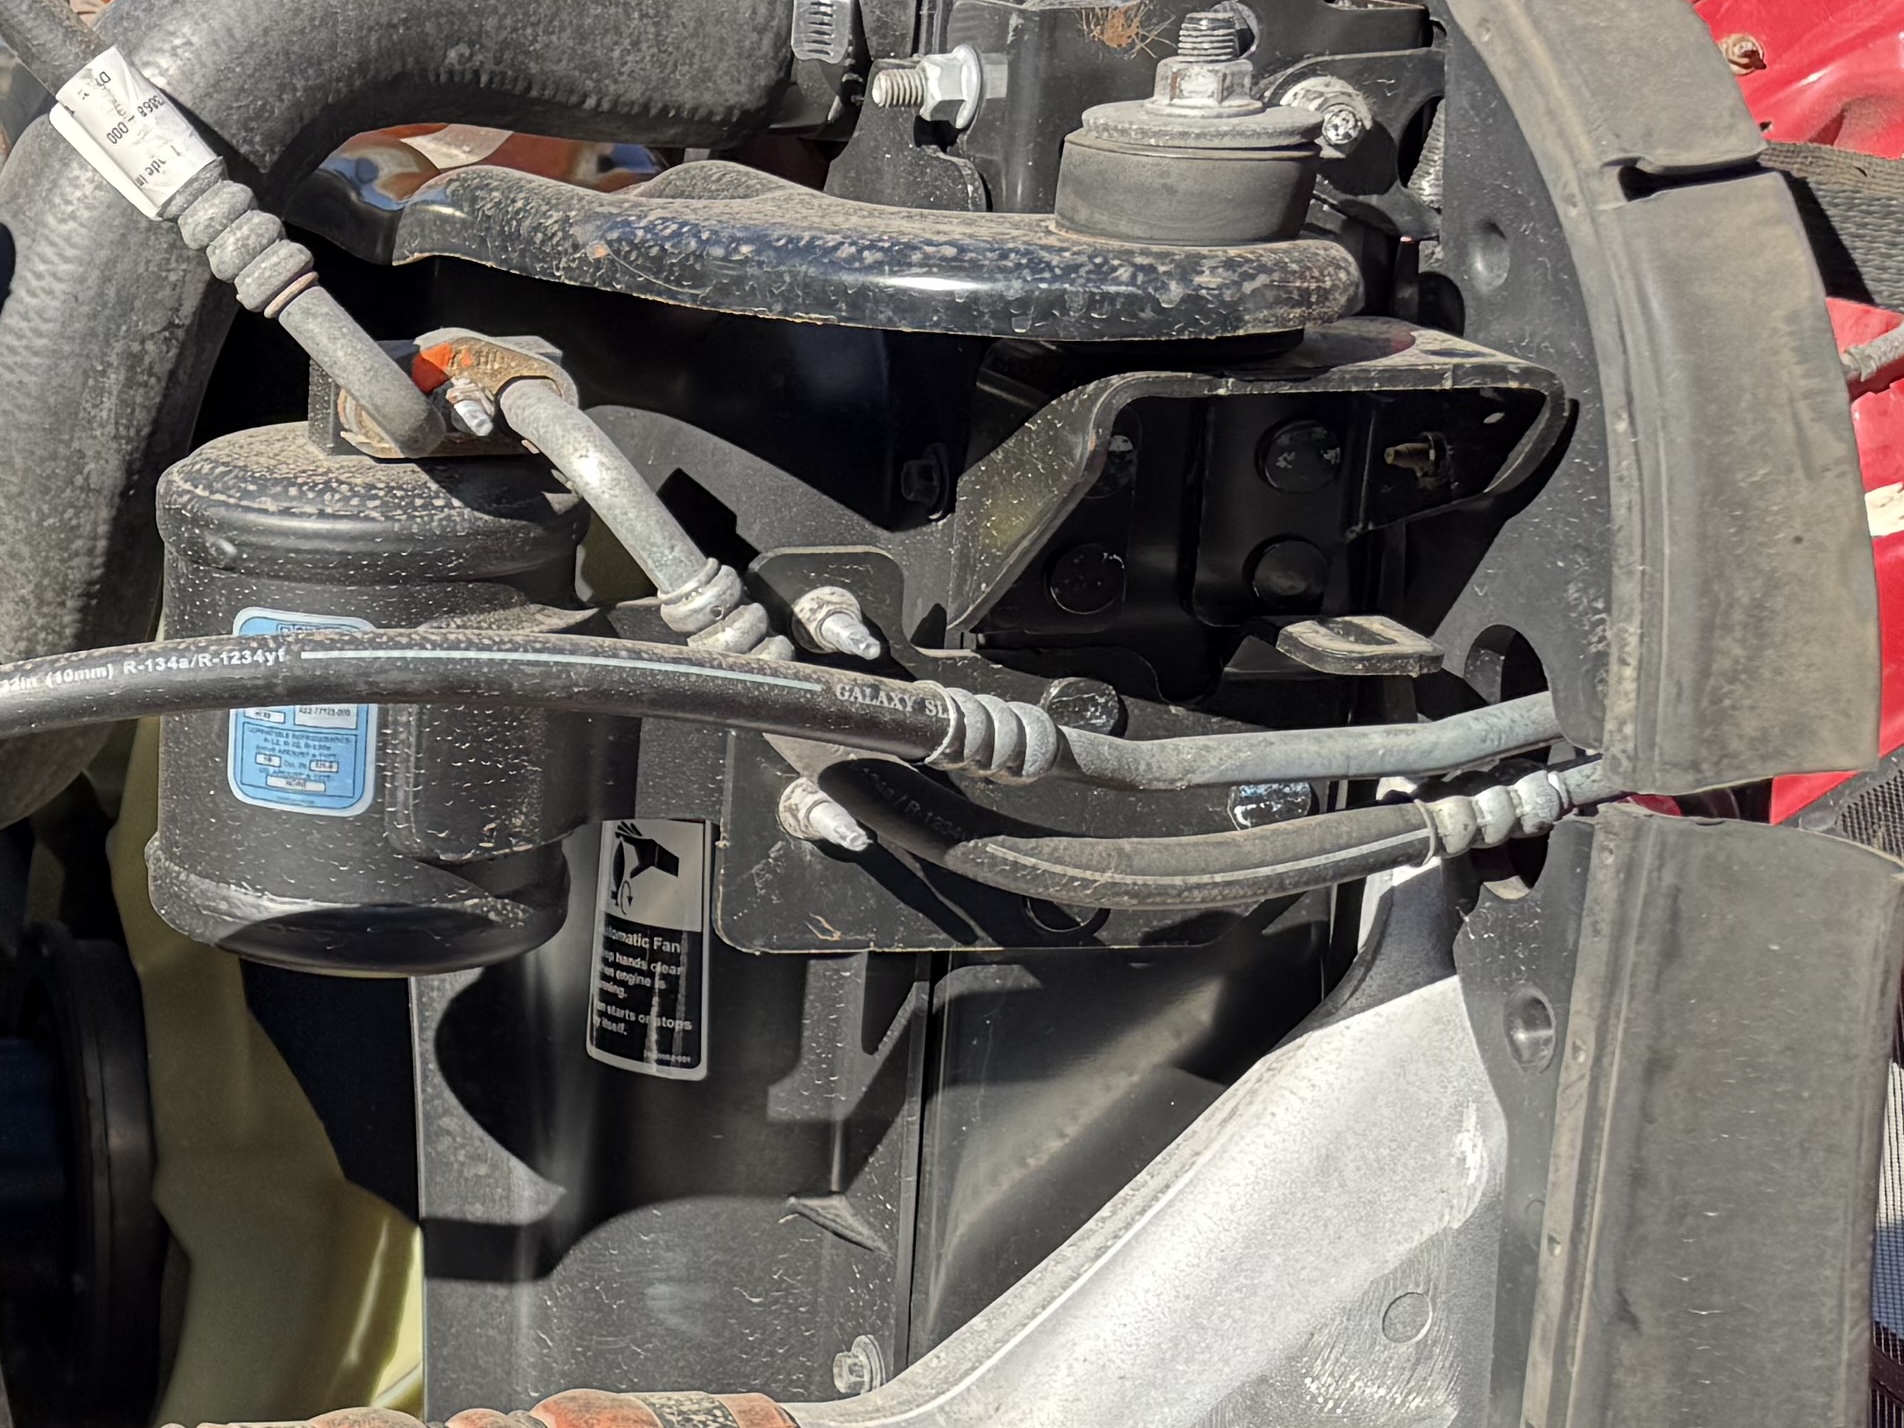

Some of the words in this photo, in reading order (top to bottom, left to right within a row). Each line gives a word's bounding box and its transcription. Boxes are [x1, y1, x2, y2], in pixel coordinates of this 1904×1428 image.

[46, 663, 114, 689] (10mm)
[123, 648, 286, 674] R-134a/R-1234yf
[836, 685, 916, 711] GALAXY
[925, 700, 950, 718] SL
[653, 937, 681, 953] Fan
[616, 952, 648, 970] hands
[650, 962, 682, 975] clear
[616, 969, 652, 987] engine
[607, 1004, 636, 1021] starts
